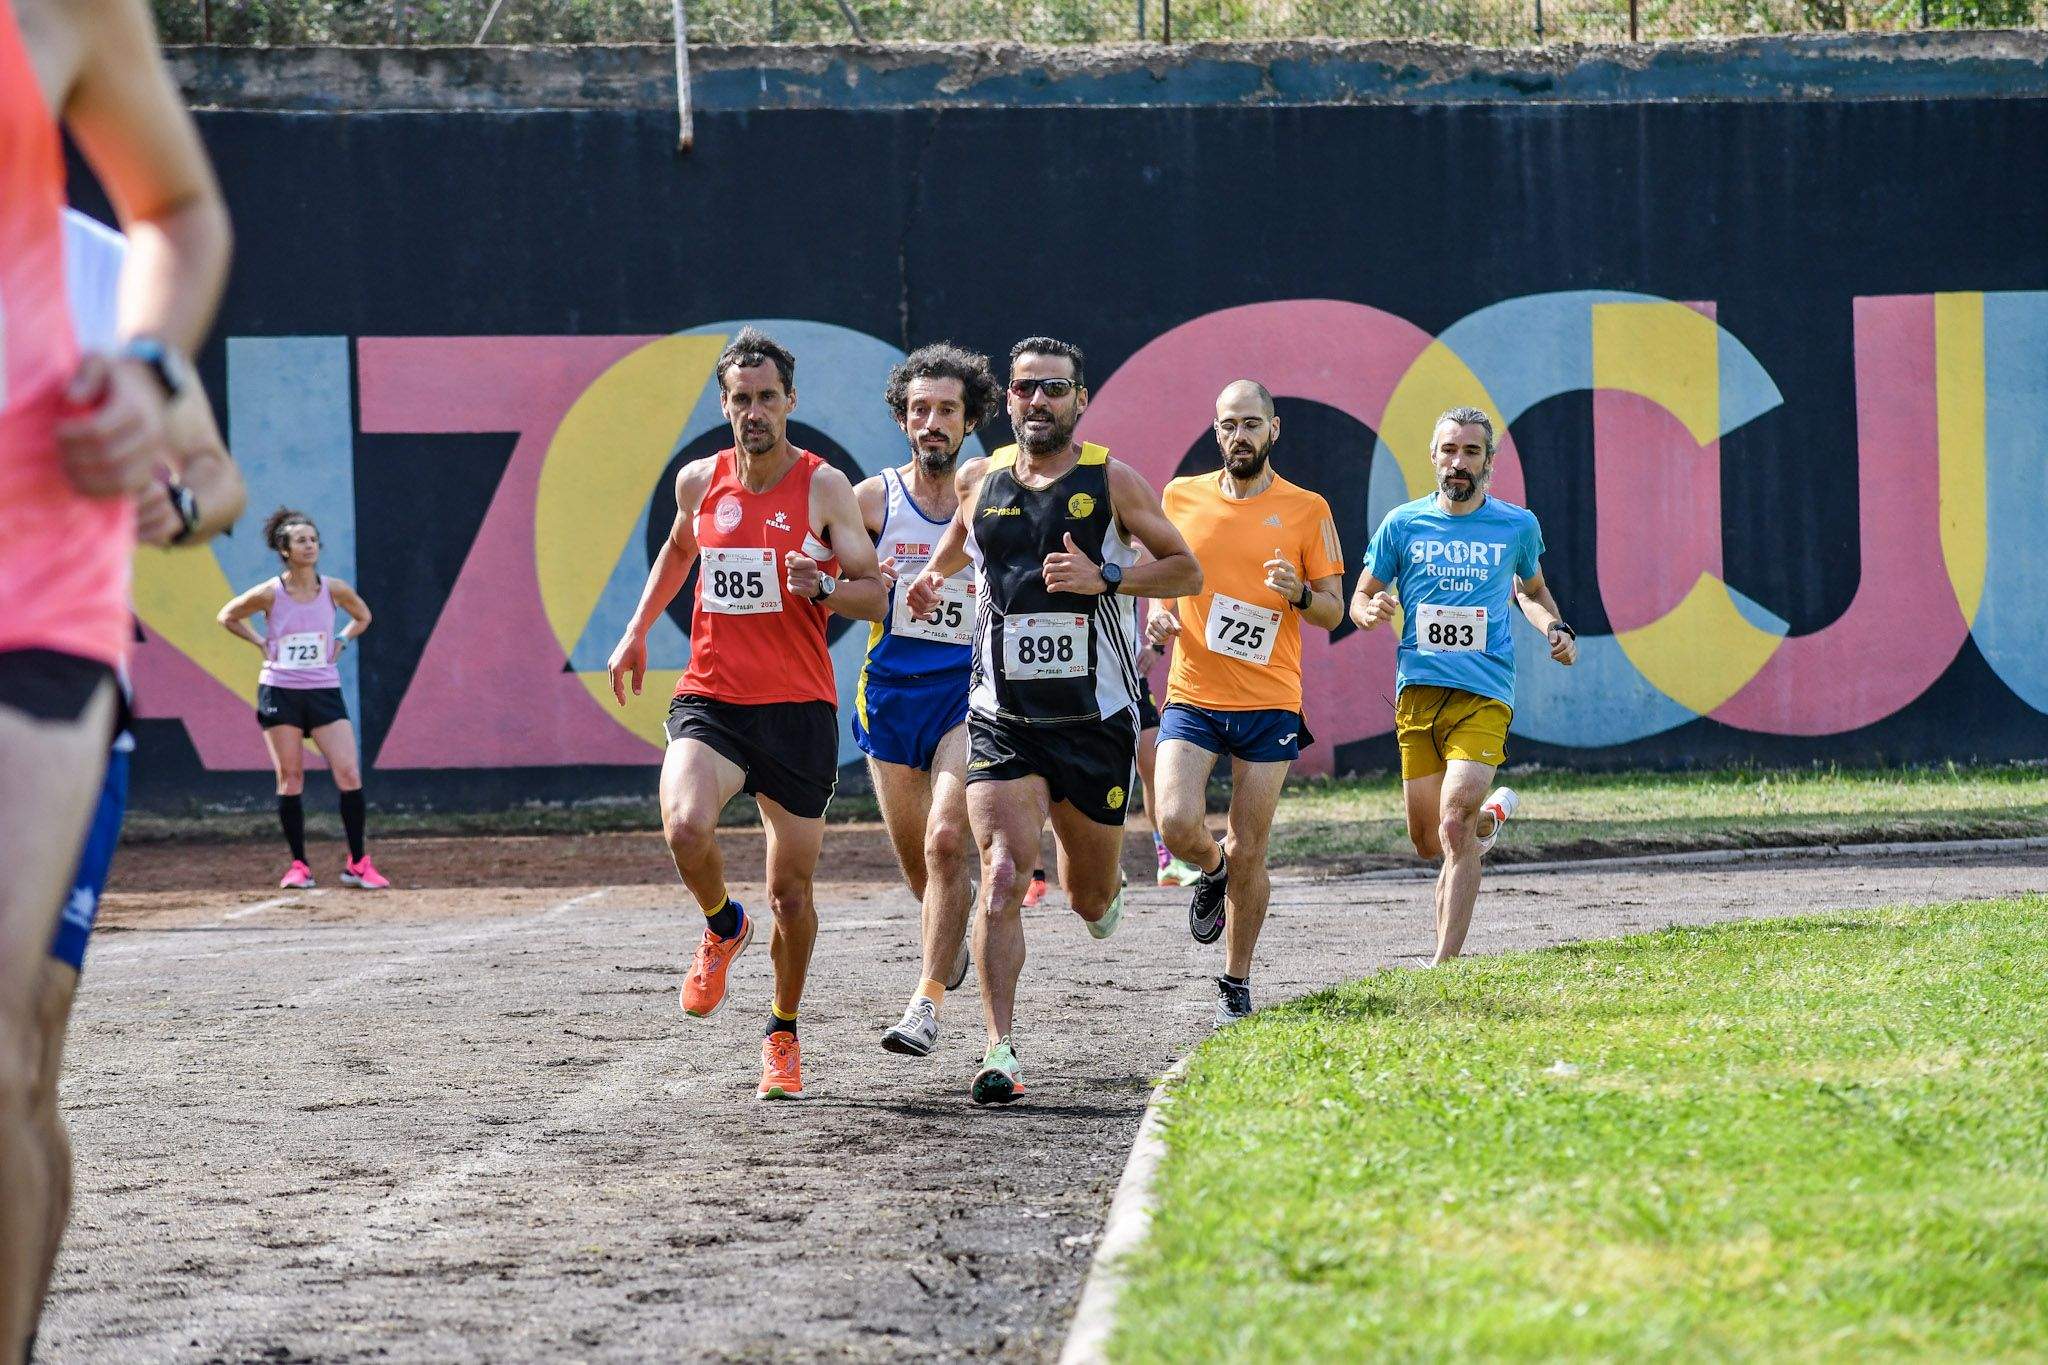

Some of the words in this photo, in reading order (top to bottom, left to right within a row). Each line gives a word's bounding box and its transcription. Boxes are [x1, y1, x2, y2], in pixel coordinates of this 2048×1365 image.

[765, 518, 791, 532] KELME
[1410, 540, 1507, 566] SPORT
[1426, 563, 1489, 580] Running
[714, 570, 764, 599] 885
[1439, 578, 1474, 592] Club
[954, 632, 970, 641] 2023
[1218, 615, 1266, 649] 725
[1428, 622, 1474, 647] 883
[288, 645, 319, 660] 723
[1018, 635, 1074, 664] 898
[1253, 653, 1266, 661] 2023
[1068, 665, 1085, 673] 2023
